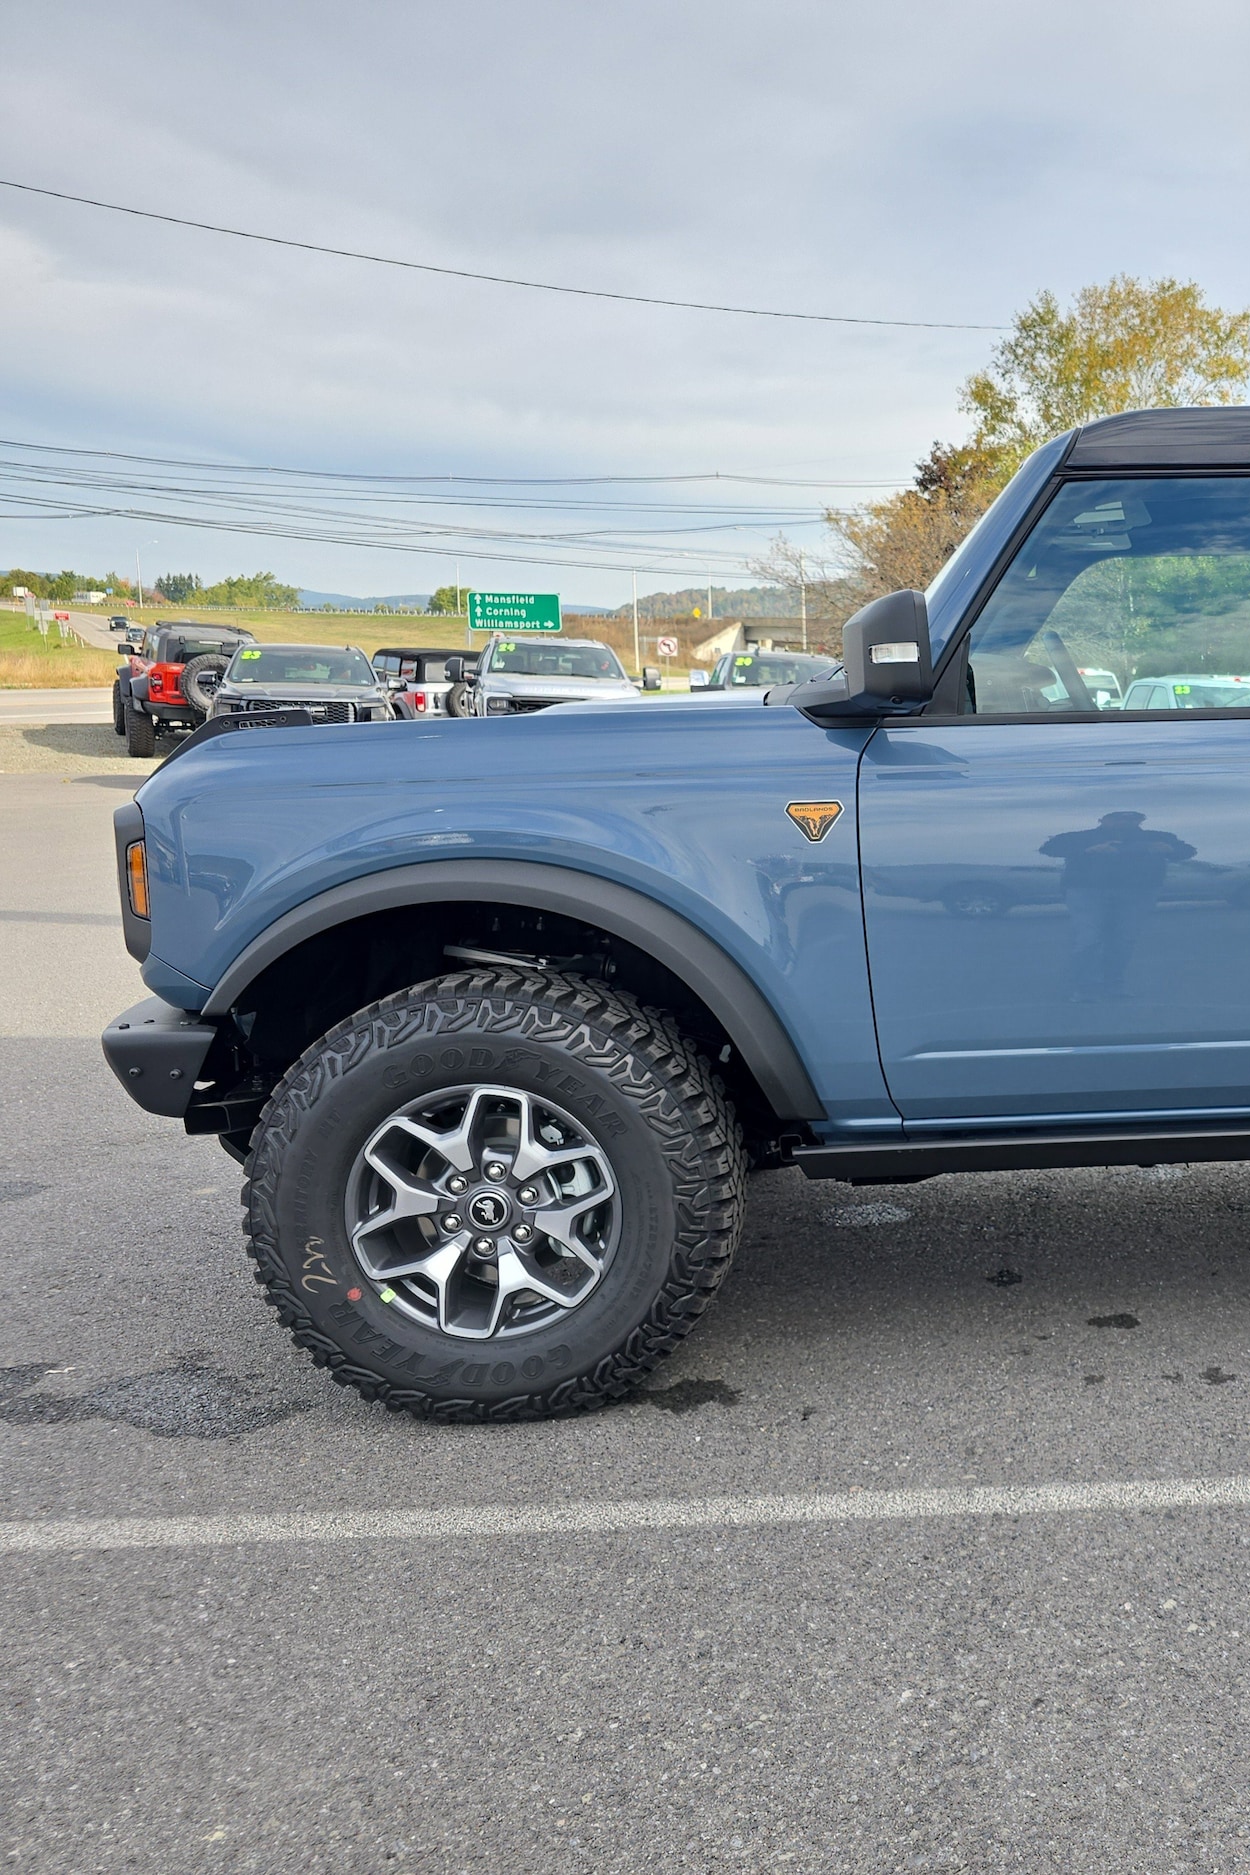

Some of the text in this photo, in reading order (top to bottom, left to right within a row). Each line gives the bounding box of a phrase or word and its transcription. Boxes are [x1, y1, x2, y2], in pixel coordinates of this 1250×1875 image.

[485, 595, 535, 604] Mansfield
[486, 607, 527, 618] Corning
[475, 620, 541, 630] Williamsport
